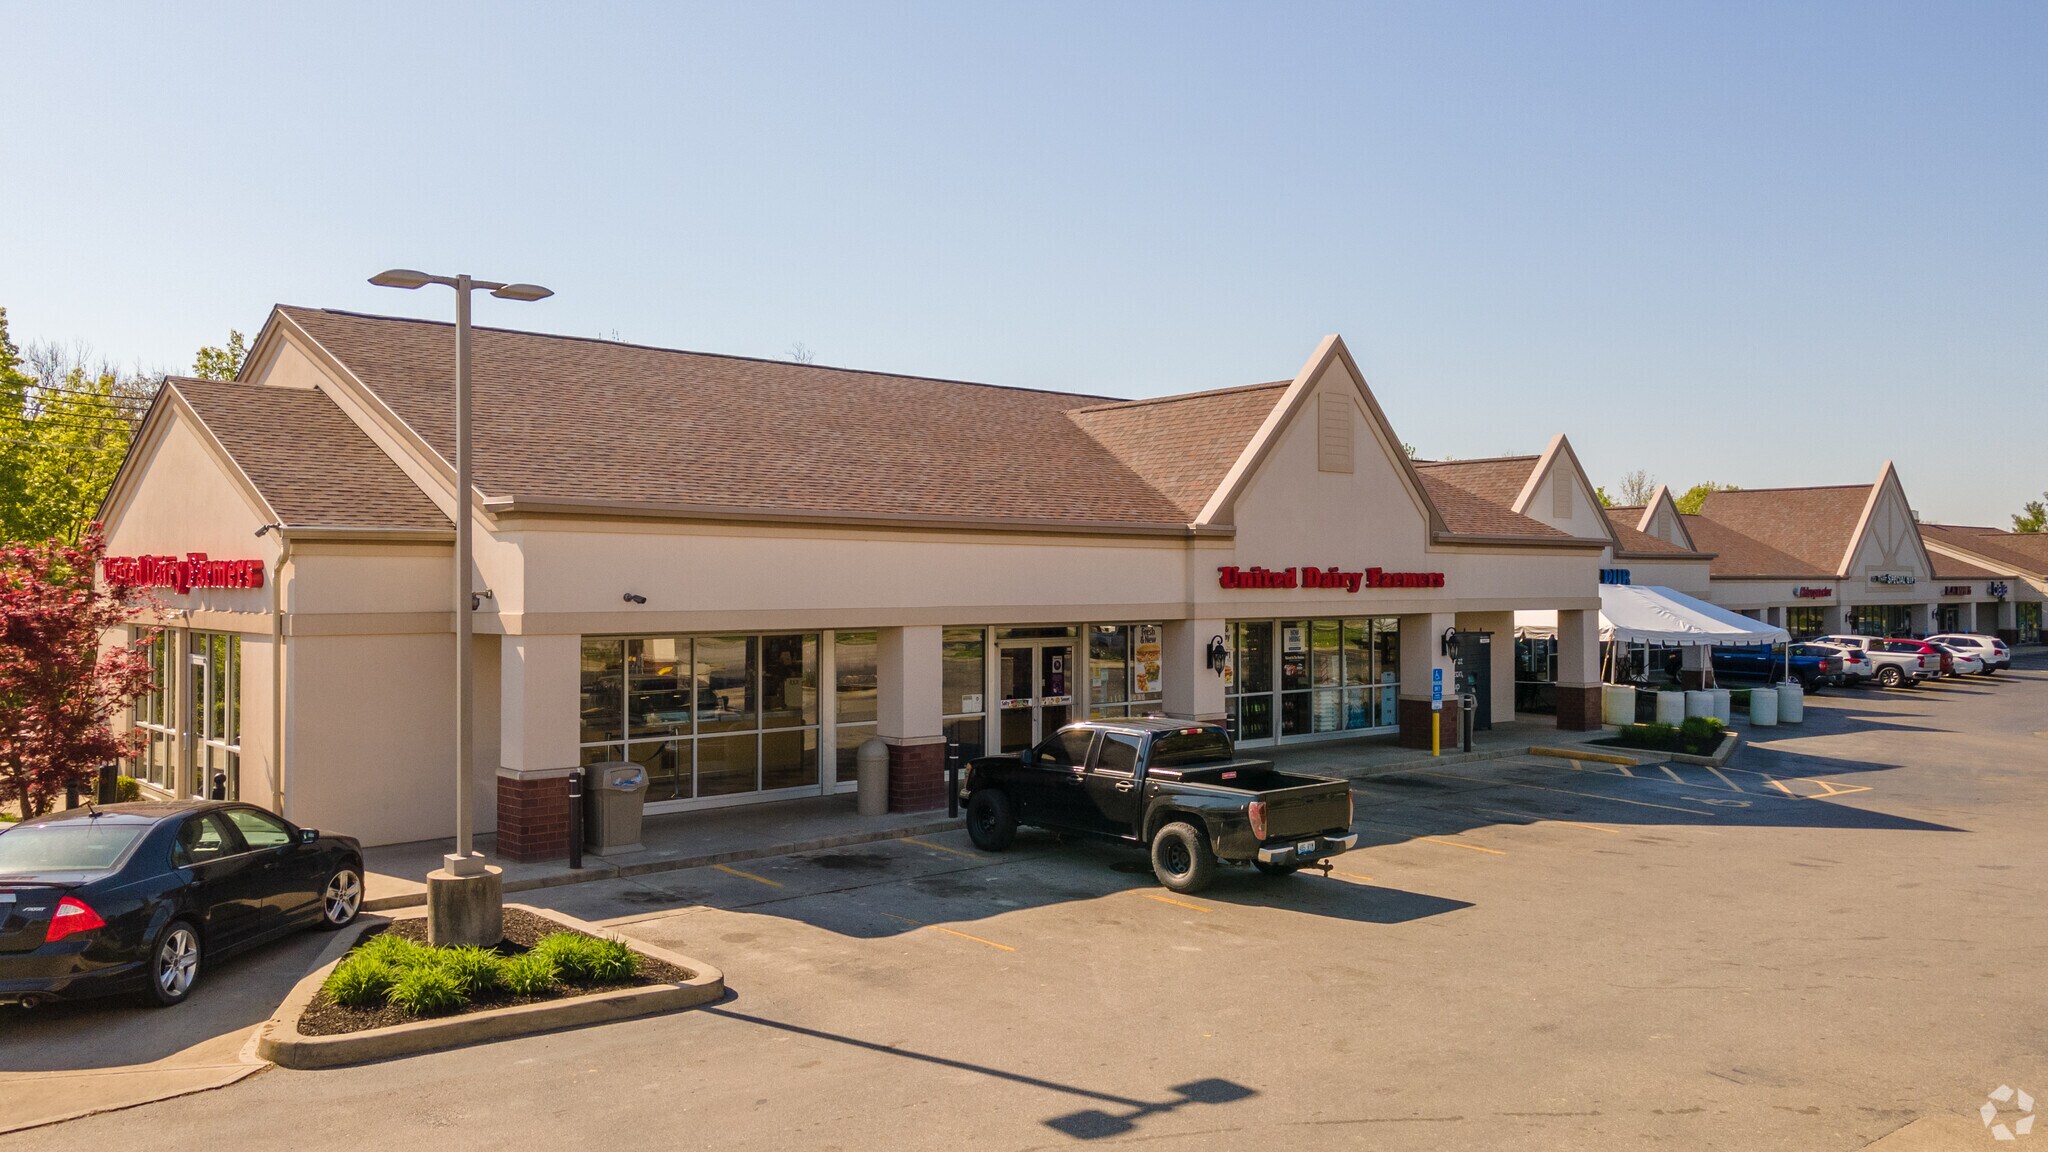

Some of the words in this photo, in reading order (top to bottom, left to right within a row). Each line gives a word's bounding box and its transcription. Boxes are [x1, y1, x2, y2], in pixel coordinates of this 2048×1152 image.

[187, 553, 264, 588] Farmers
[1218, 566, 1298, 588] United
[1301, 566, 1363, 593] Dairy
[1365, 567, 1445, 588] Farmers
[1600, 569, 1631, 584] PUB
